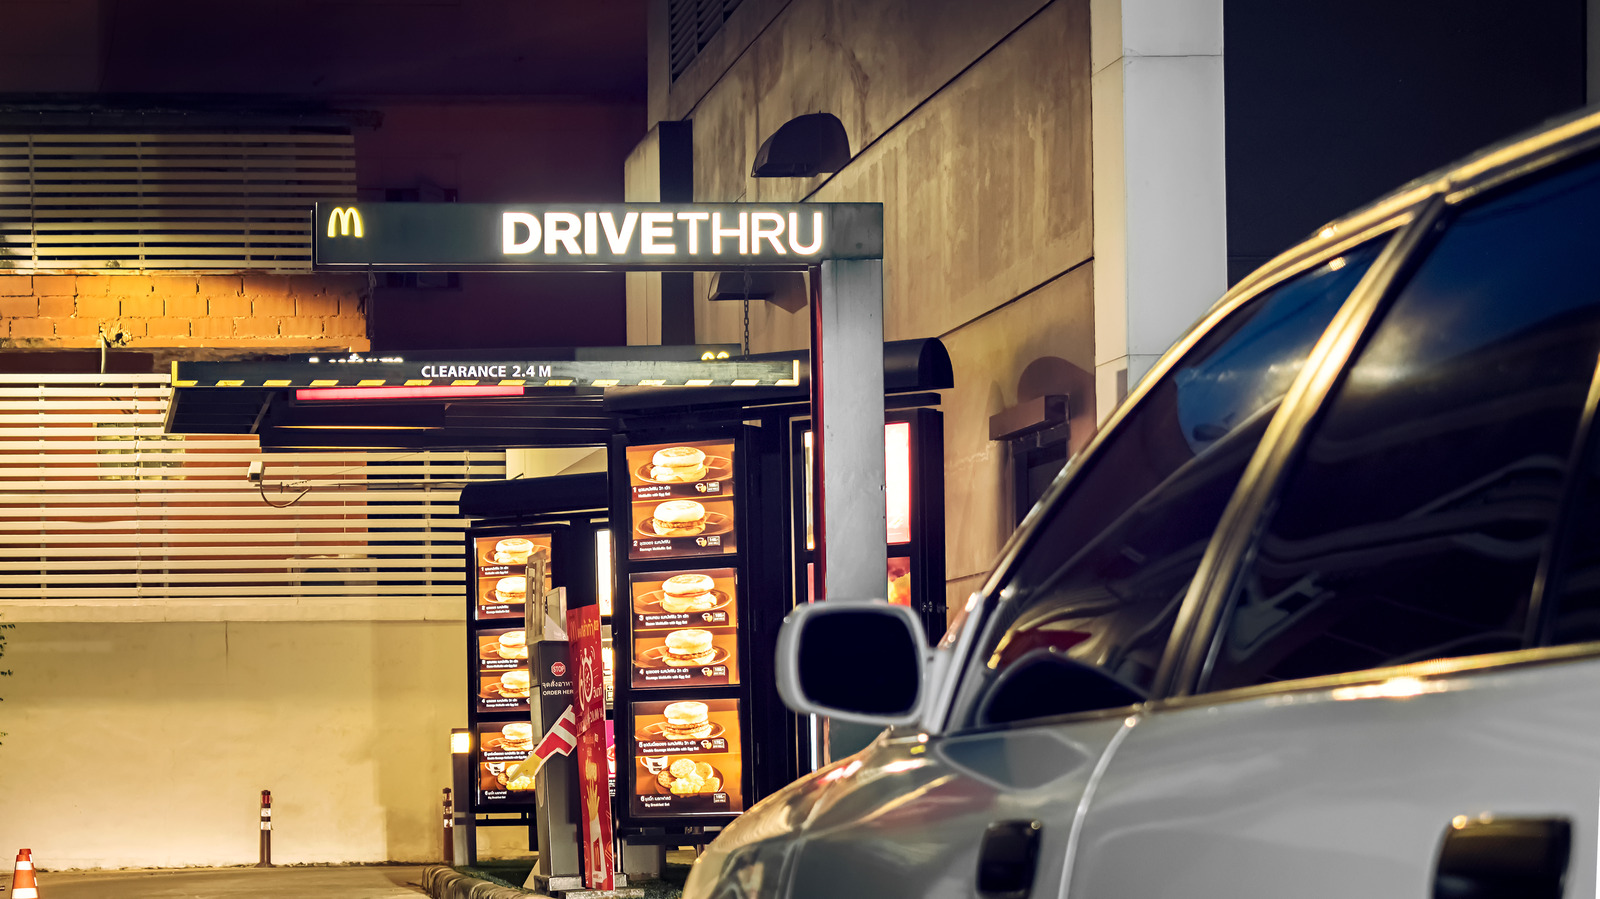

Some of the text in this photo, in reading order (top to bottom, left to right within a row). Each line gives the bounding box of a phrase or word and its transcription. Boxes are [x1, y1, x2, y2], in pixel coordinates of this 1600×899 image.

[421, 365, 552, 378] CLEARANCE 2.4 M
[552, 665, 565, 673] STOP
